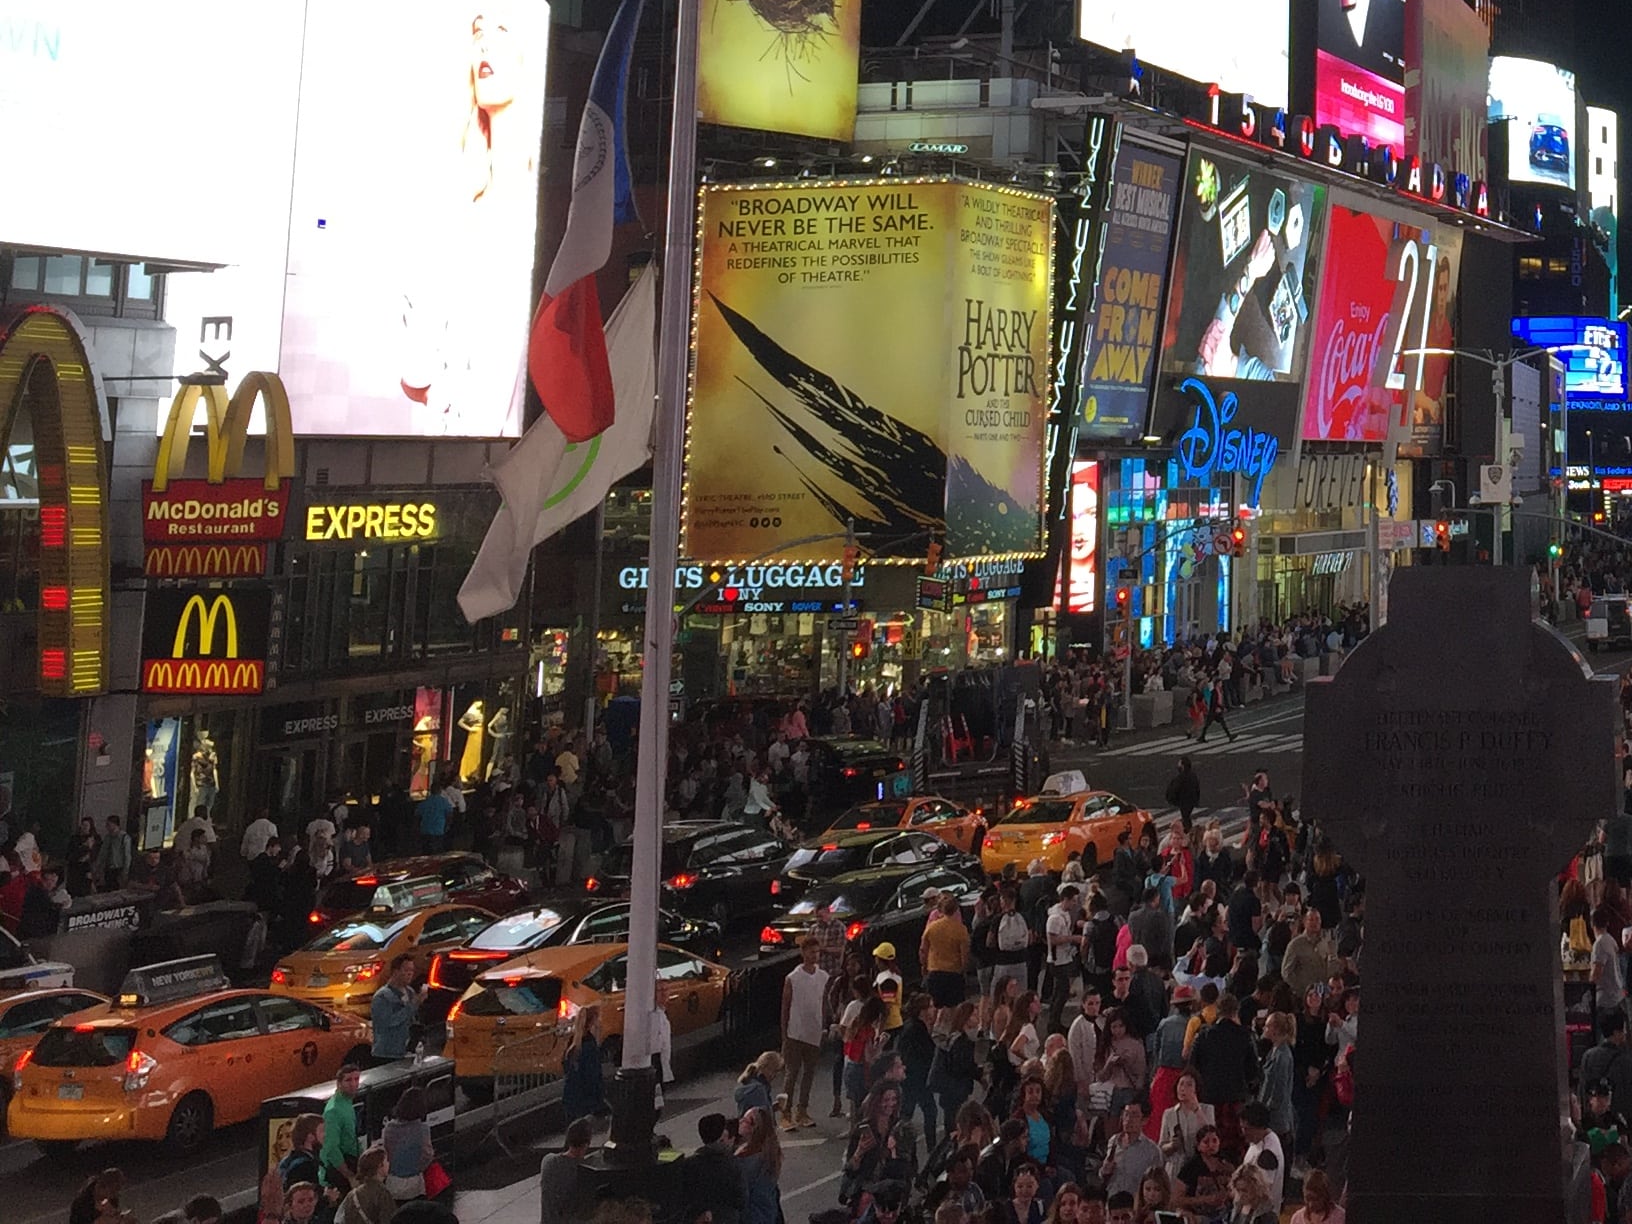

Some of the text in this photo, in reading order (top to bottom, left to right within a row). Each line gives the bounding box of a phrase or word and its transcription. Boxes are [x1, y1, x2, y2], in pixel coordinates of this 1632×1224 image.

[1208, 83, 1314, 156] 1540
[914, 143, 962, 154] LAMAR
[867, 193, 918, 211] WILL
[972, 198, 1000, 214] WILDLY
[1002, 203, 1046, 223] THEATRICAL
[1115, 183, 1170, 220] BEST MUSICAL
[718, 213, 934, 238] NEVER BE THE SAME.
[976, 216, 1032, 237] AND THRILLING
[728, 236, 921, 253] A THEATRICAL MARVEL THAT
[960, 229, 1004, 247] BROADWAY
[727, 252, 919, 270] REDEFINES THE POSSIBILITIES
[778, 272, 797, 284] OF
[1104, 266, 1161, 308] COME
[1350, 302, 1370, 324] Enjoy
[1385, 239, 1438, 391] 21
[964, 298, 1038, 354] HARRY
[956, 346, 1040, 398] POTTER
[1090, 343, 1152, 384] AWAY
[965, 409, 1031, 428] CURSED CHILD
[147, 499, 279, 520] McDonald's
[168, 522, 255, 535] Restaurant
[306, 504, 436, 541] EXPRESS
[975, 560, 1025, 576] LUGGAGE
[1312, 552, 1345, 575] FOREVER
[619, 567, 703, 589] GITS
[738, 588, 763, 600] NY
[744, 603, 783, 612] SONY
[365, 705, 414, 723] EXPRESS
[285, 715, 339, 735] EXPRESS
[1365, 730, 1451, 751] FRANCIS
[1481, 730, 1553, 750] DUFFY
[68, 906, 136, 928] BROADWAY'S
[152, 973, 174, 987] NEW
